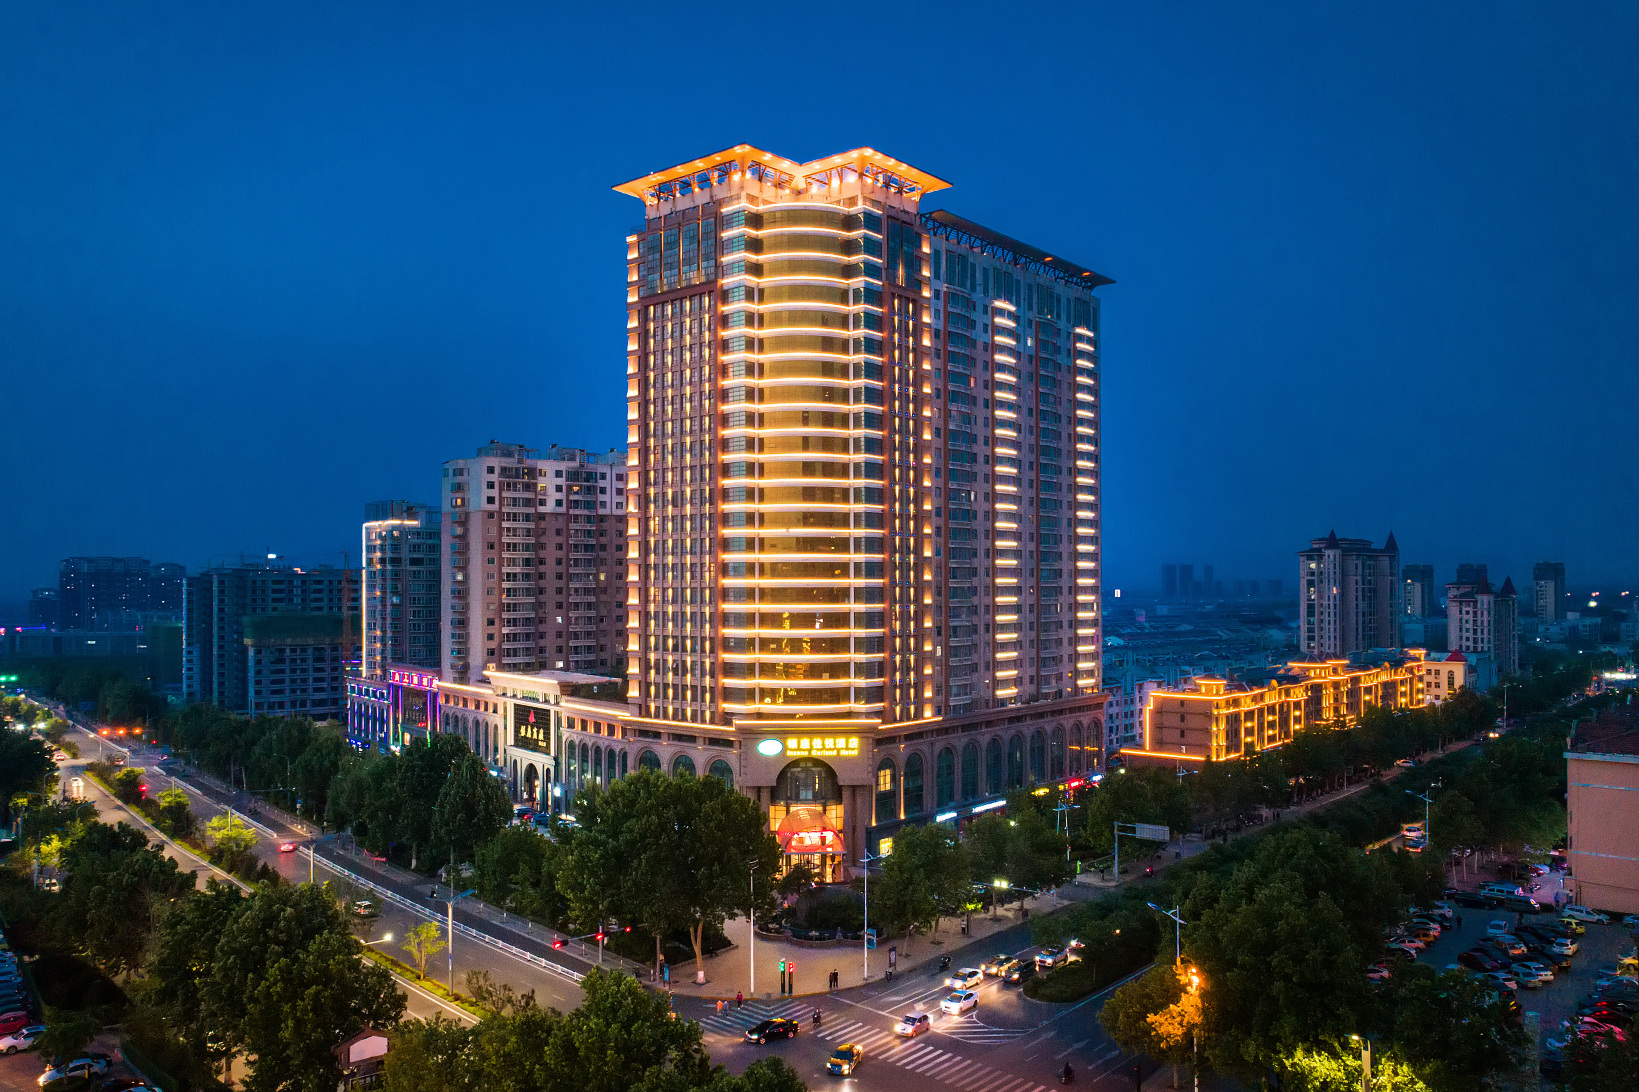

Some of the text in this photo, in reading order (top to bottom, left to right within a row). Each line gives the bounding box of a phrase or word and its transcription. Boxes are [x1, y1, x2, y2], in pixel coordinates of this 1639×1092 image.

[787, 737, 859, 749] 银座佳悦酒店
